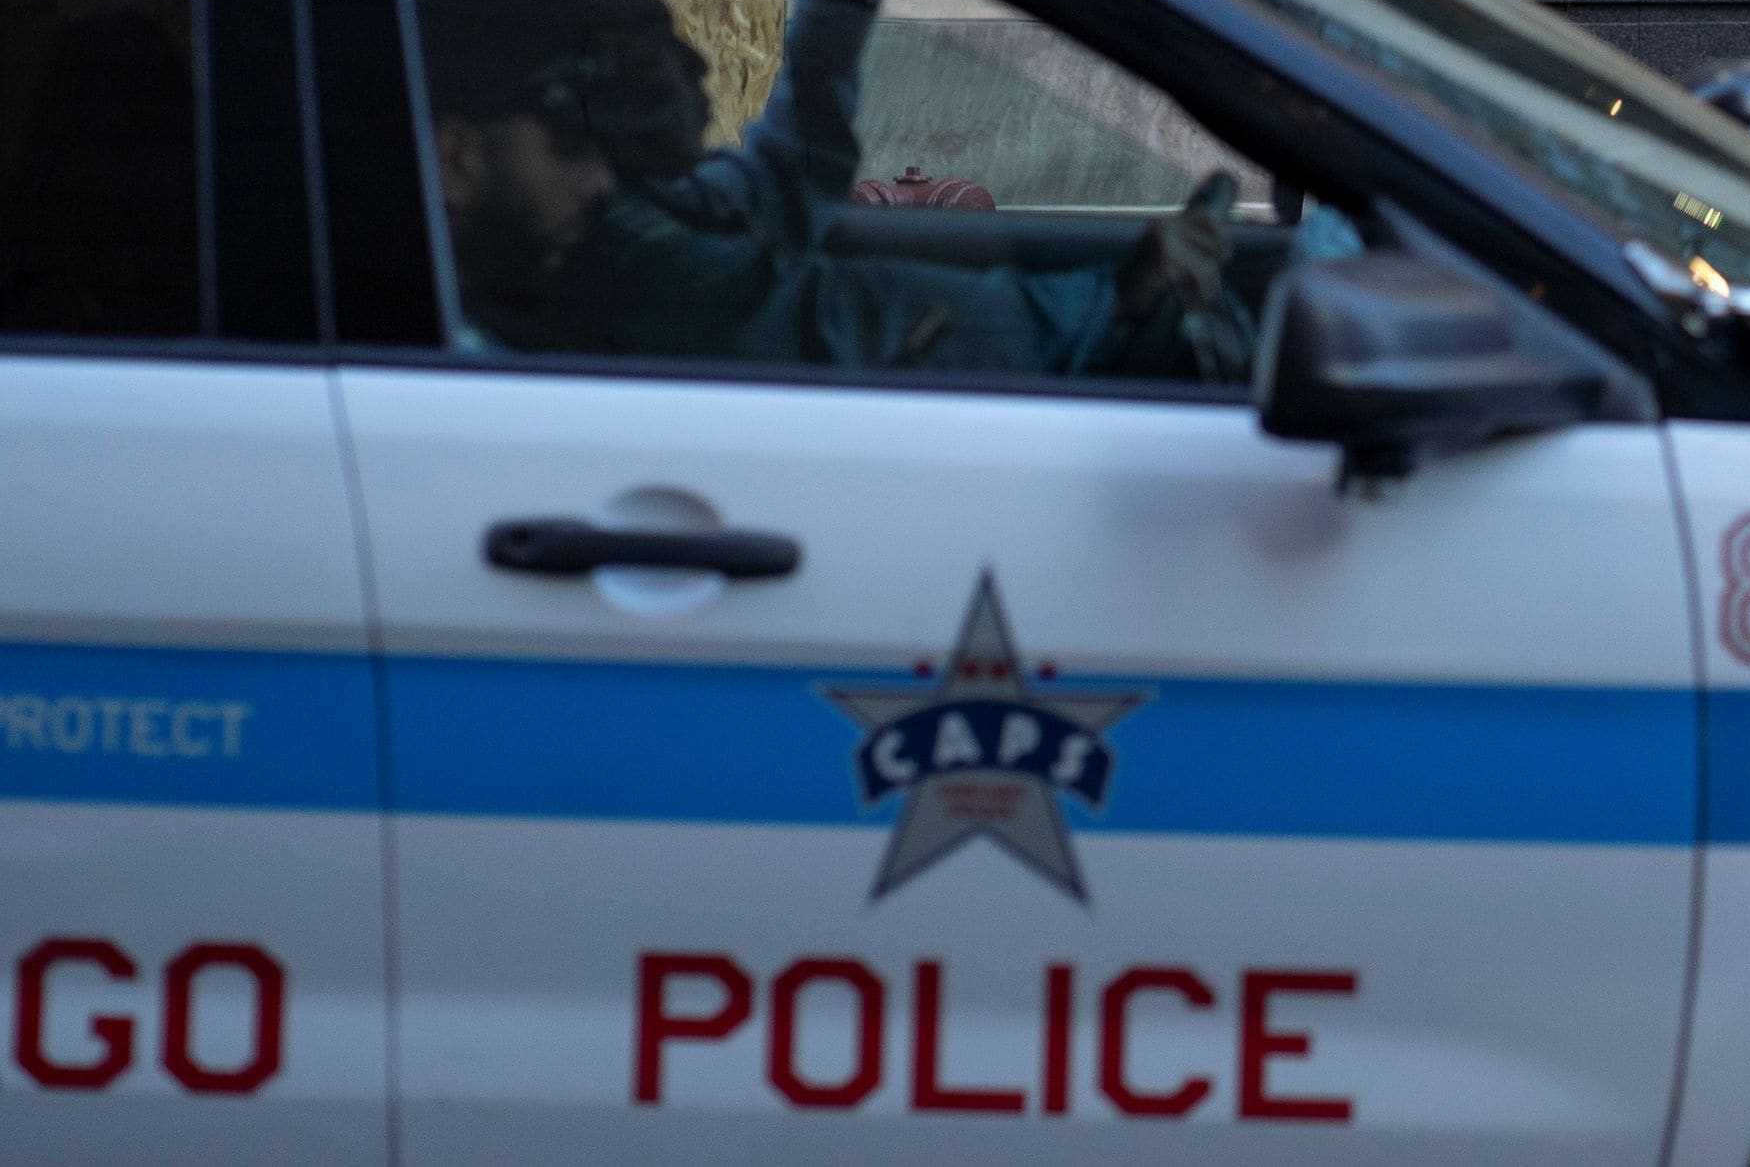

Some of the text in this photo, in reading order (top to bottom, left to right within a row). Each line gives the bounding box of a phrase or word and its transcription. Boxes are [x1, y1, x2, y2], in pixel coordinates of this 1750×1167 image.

[870, 709, 1091, 786] CAPS
[16, 936, 1359, 1125] GO POLICE
